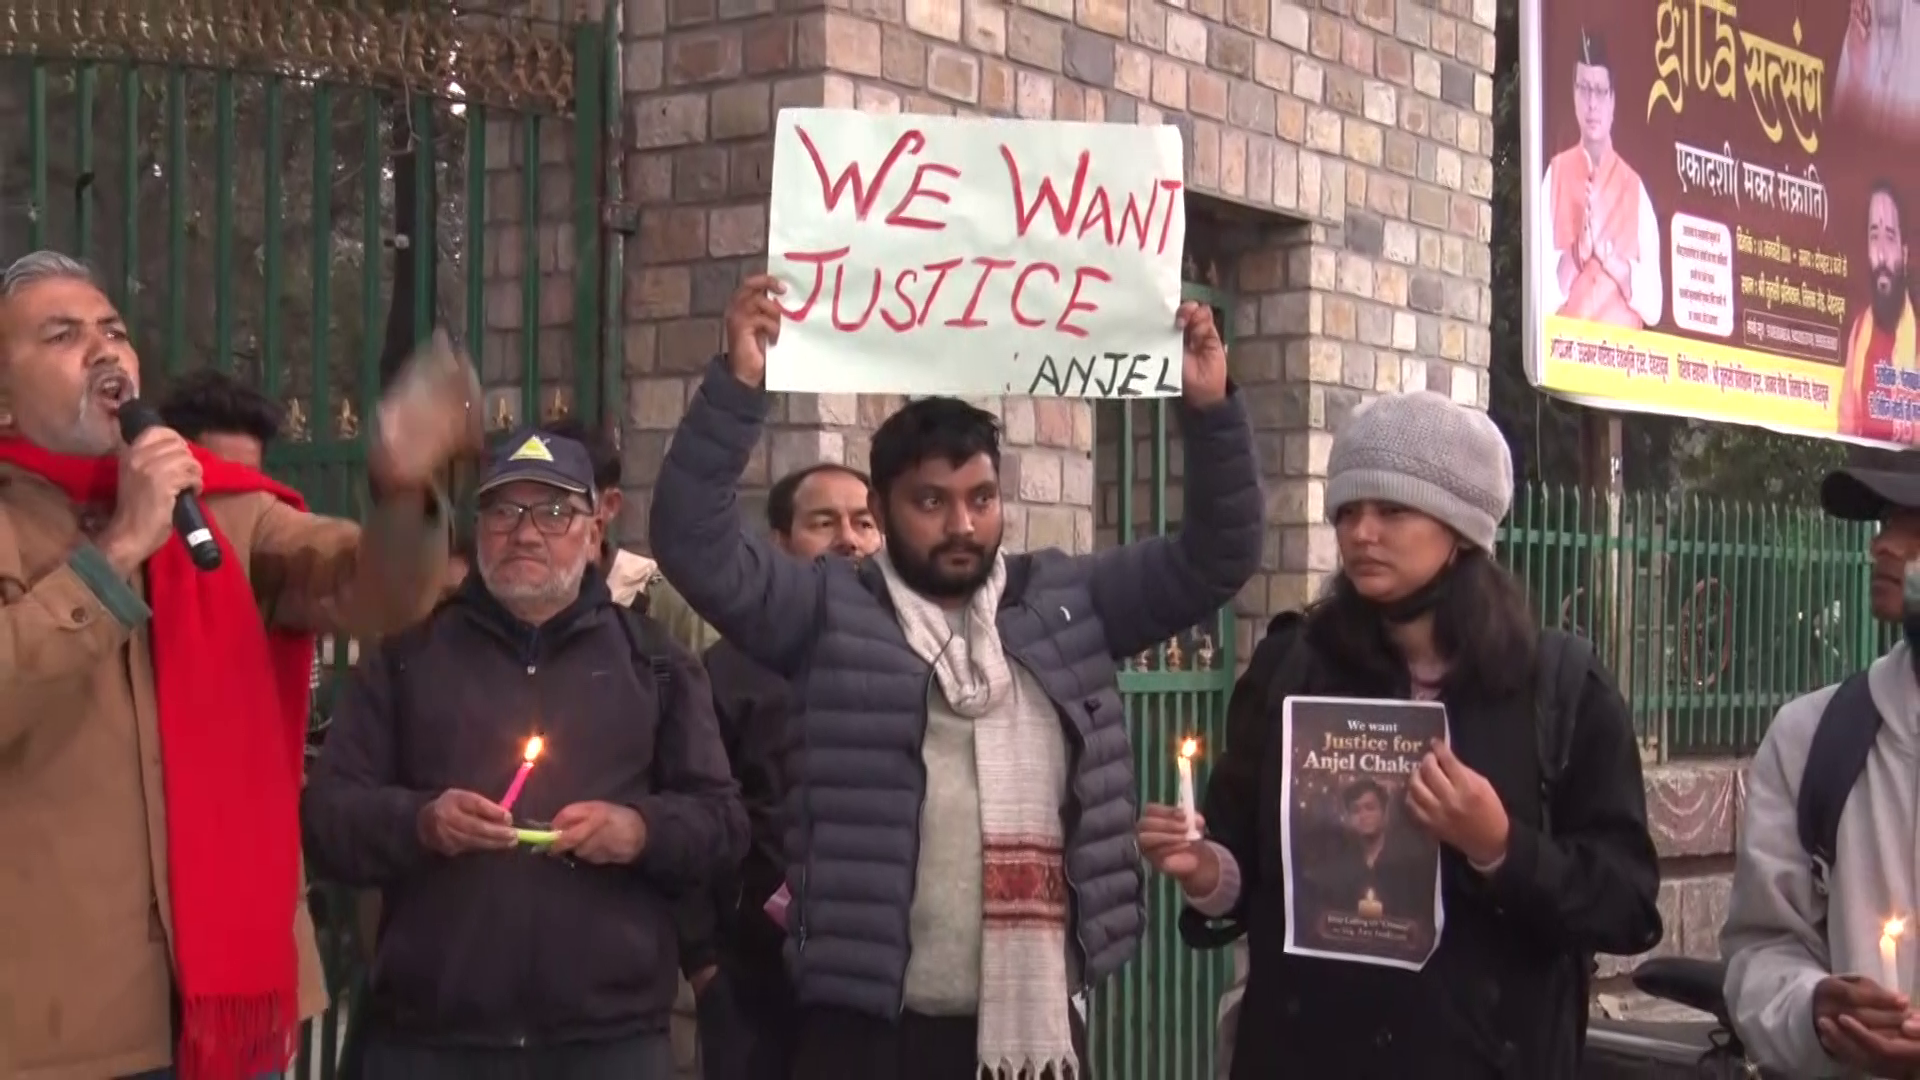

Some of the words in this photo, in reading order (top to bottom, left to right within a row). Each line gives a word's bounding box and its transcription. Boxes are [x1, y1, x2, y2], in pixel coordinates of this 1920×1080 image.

[1739, 15, 1824, 153] सत्संग
[795, 125, 961, 229] WE
[999, 144, 1183, 254] WANT
[1742, 161, 1776, 209] मकर
[773, 246, 1113, 338] JUSTICE
[1029, 352, 1181, 397] ANJEL
[1322, 732, 1388, 751] Justice
[1393, 735, 1422, 753] for
[1347, 719, 1366, 731] We
[1369, 721, 1398, 733] want
[1302, 750, 1356, 773] Anjel
